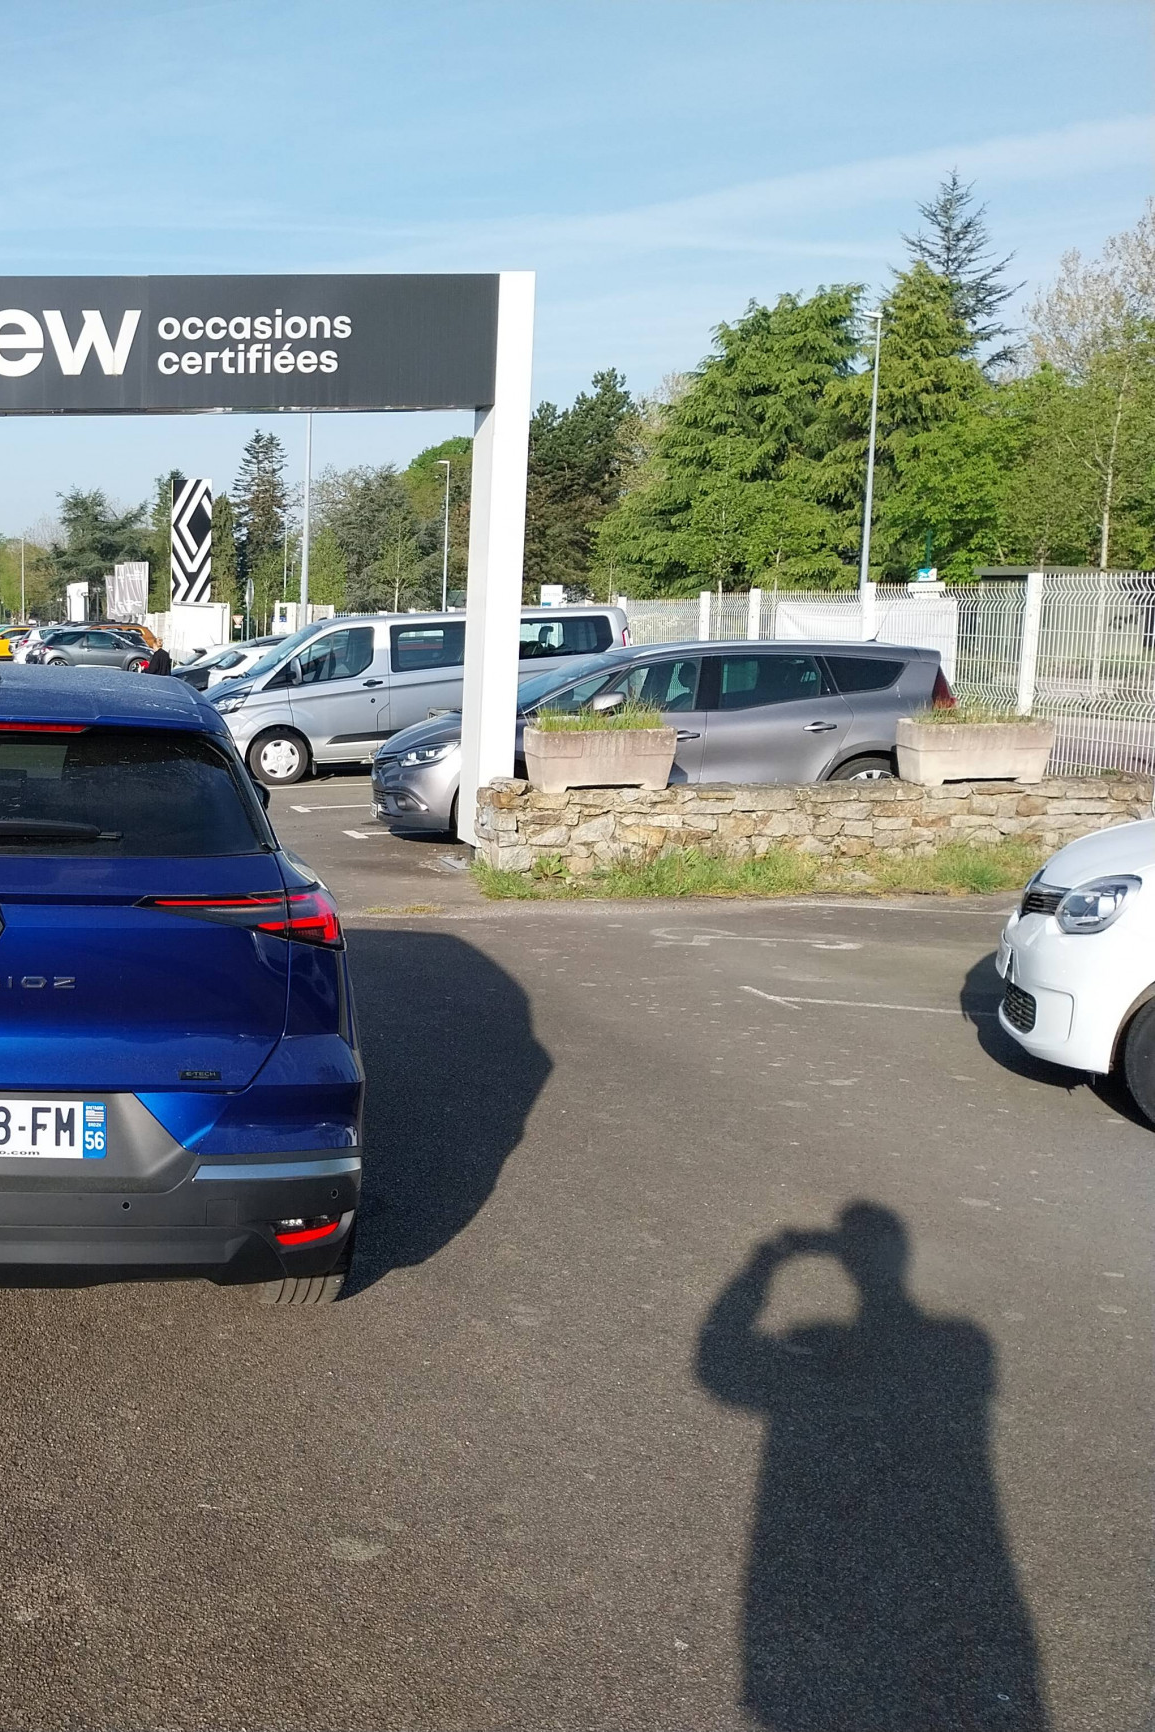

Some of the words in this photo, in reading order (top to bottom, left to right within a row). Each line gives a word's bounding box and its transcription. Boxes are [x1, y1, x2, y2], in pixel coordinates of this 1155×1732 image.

[157, 309, 353, 341] occasions
[157, 342, 339, 376] certifiées
[85, 1130, 105, 1150] 56
